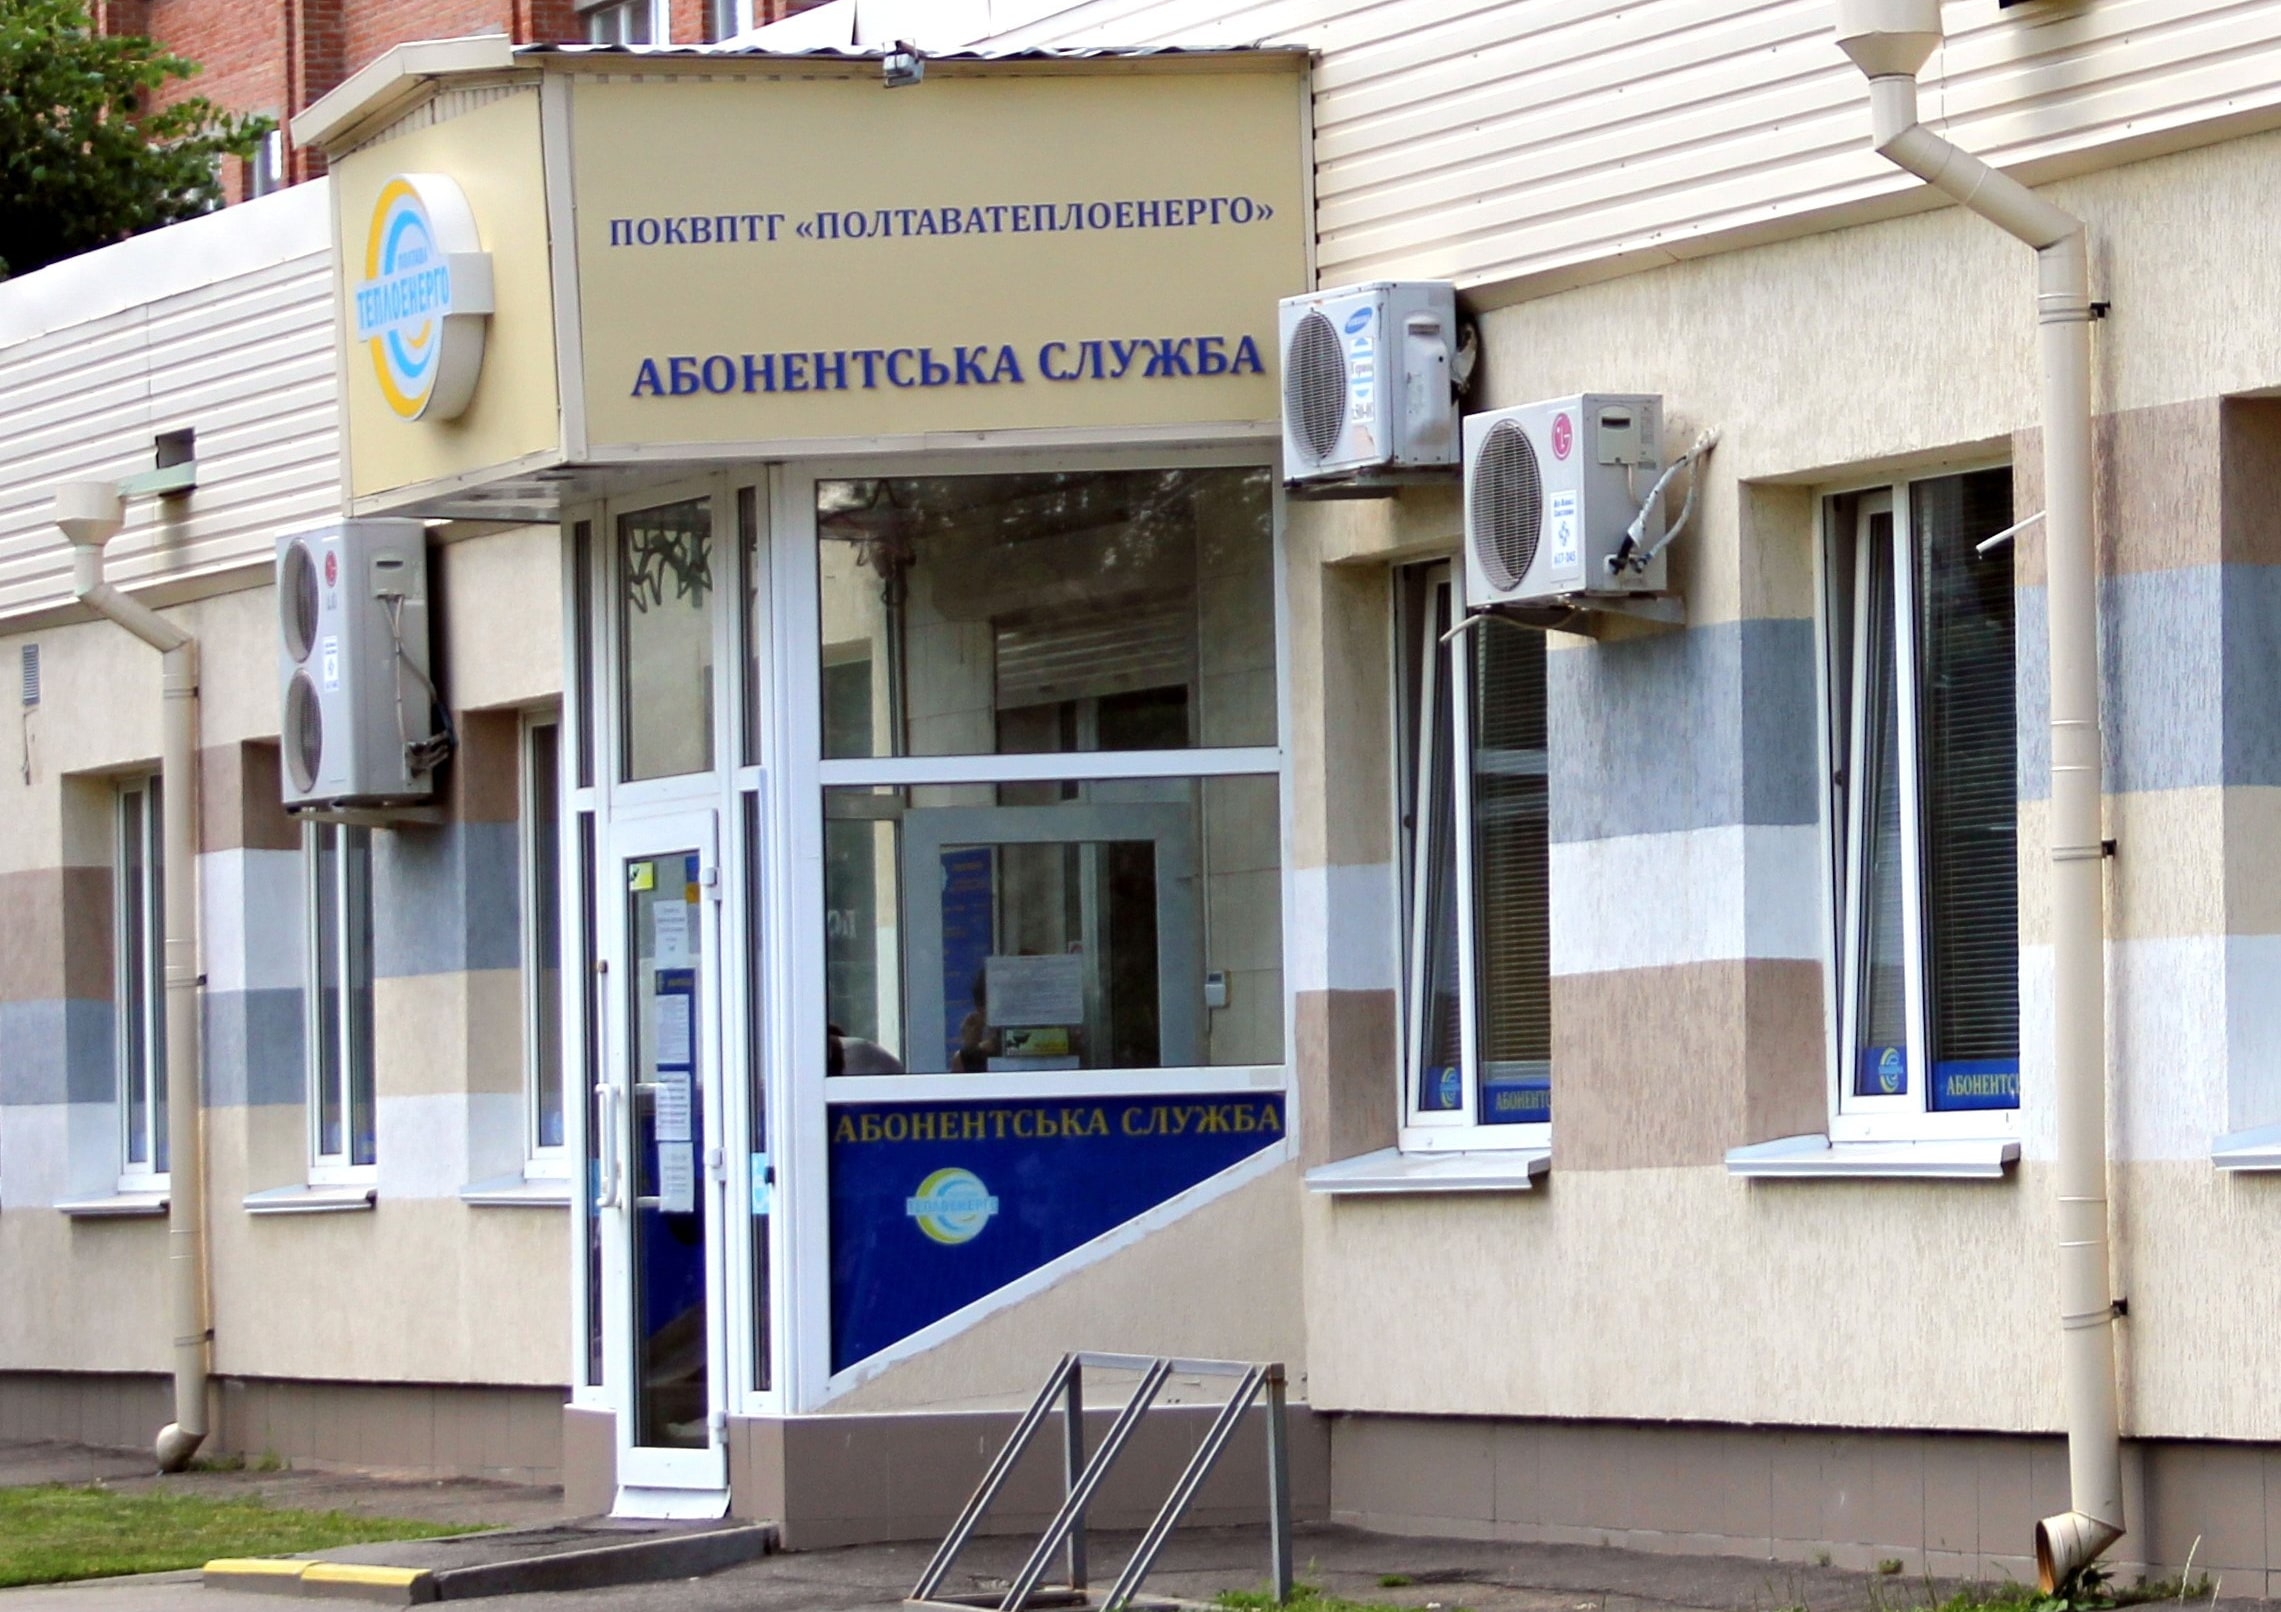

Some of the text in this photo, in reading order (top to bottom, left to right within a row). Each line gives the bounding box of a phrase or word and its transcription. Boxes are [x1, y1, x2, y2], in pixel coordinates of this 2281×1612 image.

[610, 196, 1274, 247] ПОКВПТГ «ПОЛТАВАТЕПЛОЕНЕРГО»
[357, 265, 450, 330] ТЕПЛОЕНЕРГО
[630, 334, 1265, 398] АБОНЕНТСЬКА СЛУЖБА
[834, 1103, 1282, 1143] АБОНЕНТСЬКА СЛУЖБА
